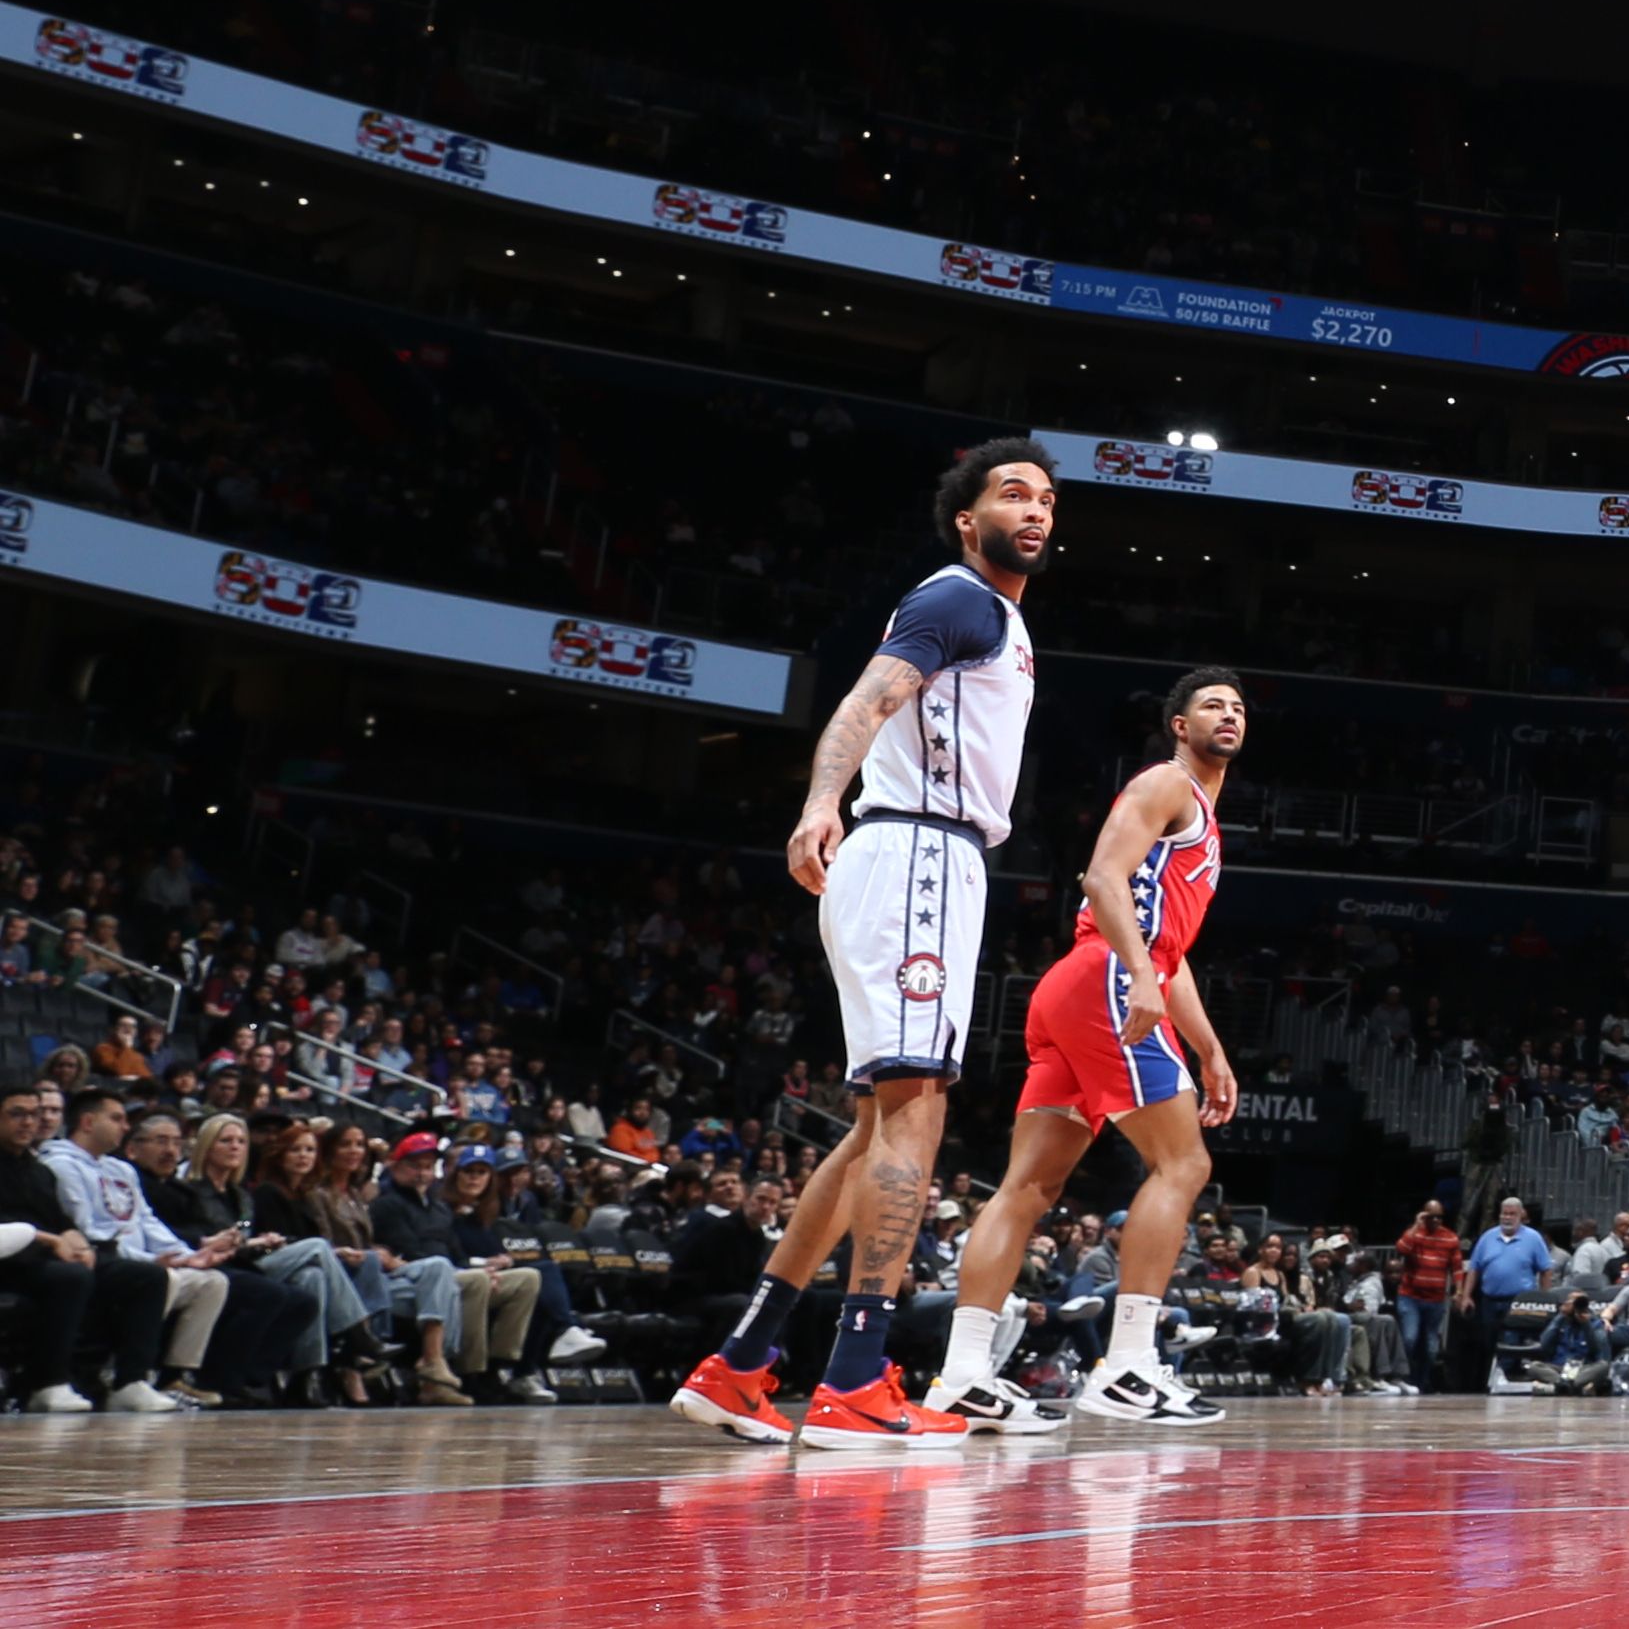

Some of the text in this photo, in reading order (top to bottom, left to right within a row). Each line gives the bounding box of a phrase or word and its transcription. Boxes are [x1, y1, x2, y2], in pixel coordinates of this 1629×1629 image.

[1061, 280, 1092, 297] 7:15
[1095, 285, 1117, 298] PM
[1178, 292, 1272, 316] FOUNDATION
[1321, 306, 1376, 321] JACKPOT
[1175, 307, 1271, 331] 50/50 RAFFLE
[1311, 318, 1392, 347] $2,270
[1235, 1093, 1318, 1122] ENTAL
[1219, 1124, 1294, 1143] CLUB
[1510, 1300, 1558, 1312] CAESARS
